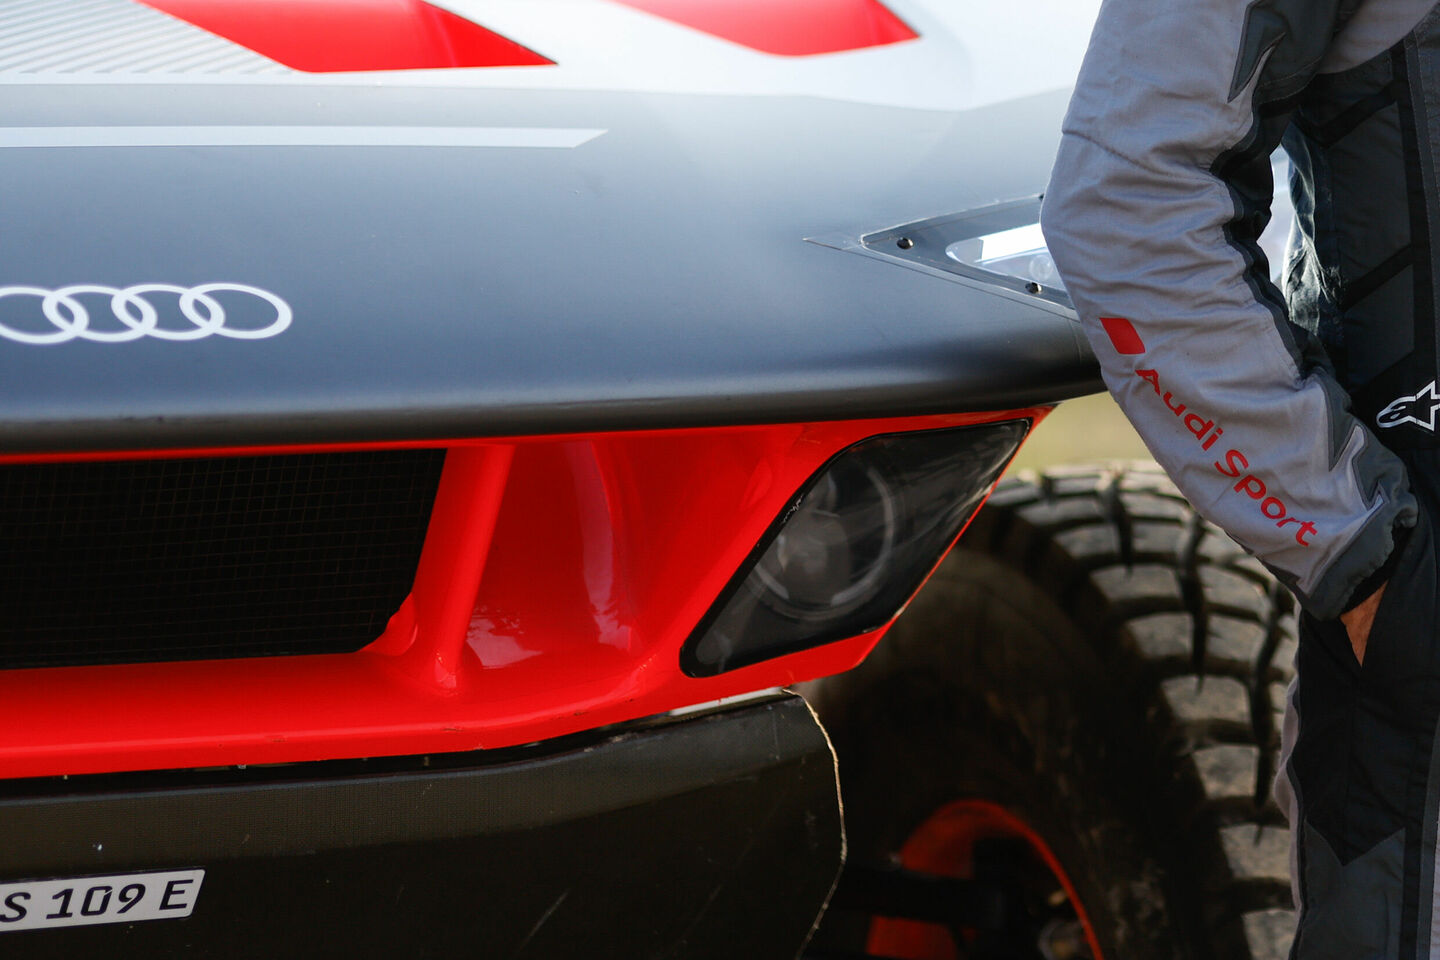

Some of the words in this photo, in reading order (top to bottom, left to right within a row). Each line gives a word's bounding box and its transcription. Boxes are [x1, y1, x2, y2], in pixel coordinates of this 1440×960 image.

[1135, 369, 1223, 451] Audi
[1214, 449, 1318, 547] Sport
[0, 891, 32, 923] S
[46, 883, 146, 920] 109
[158, 878, 194, 911] E
